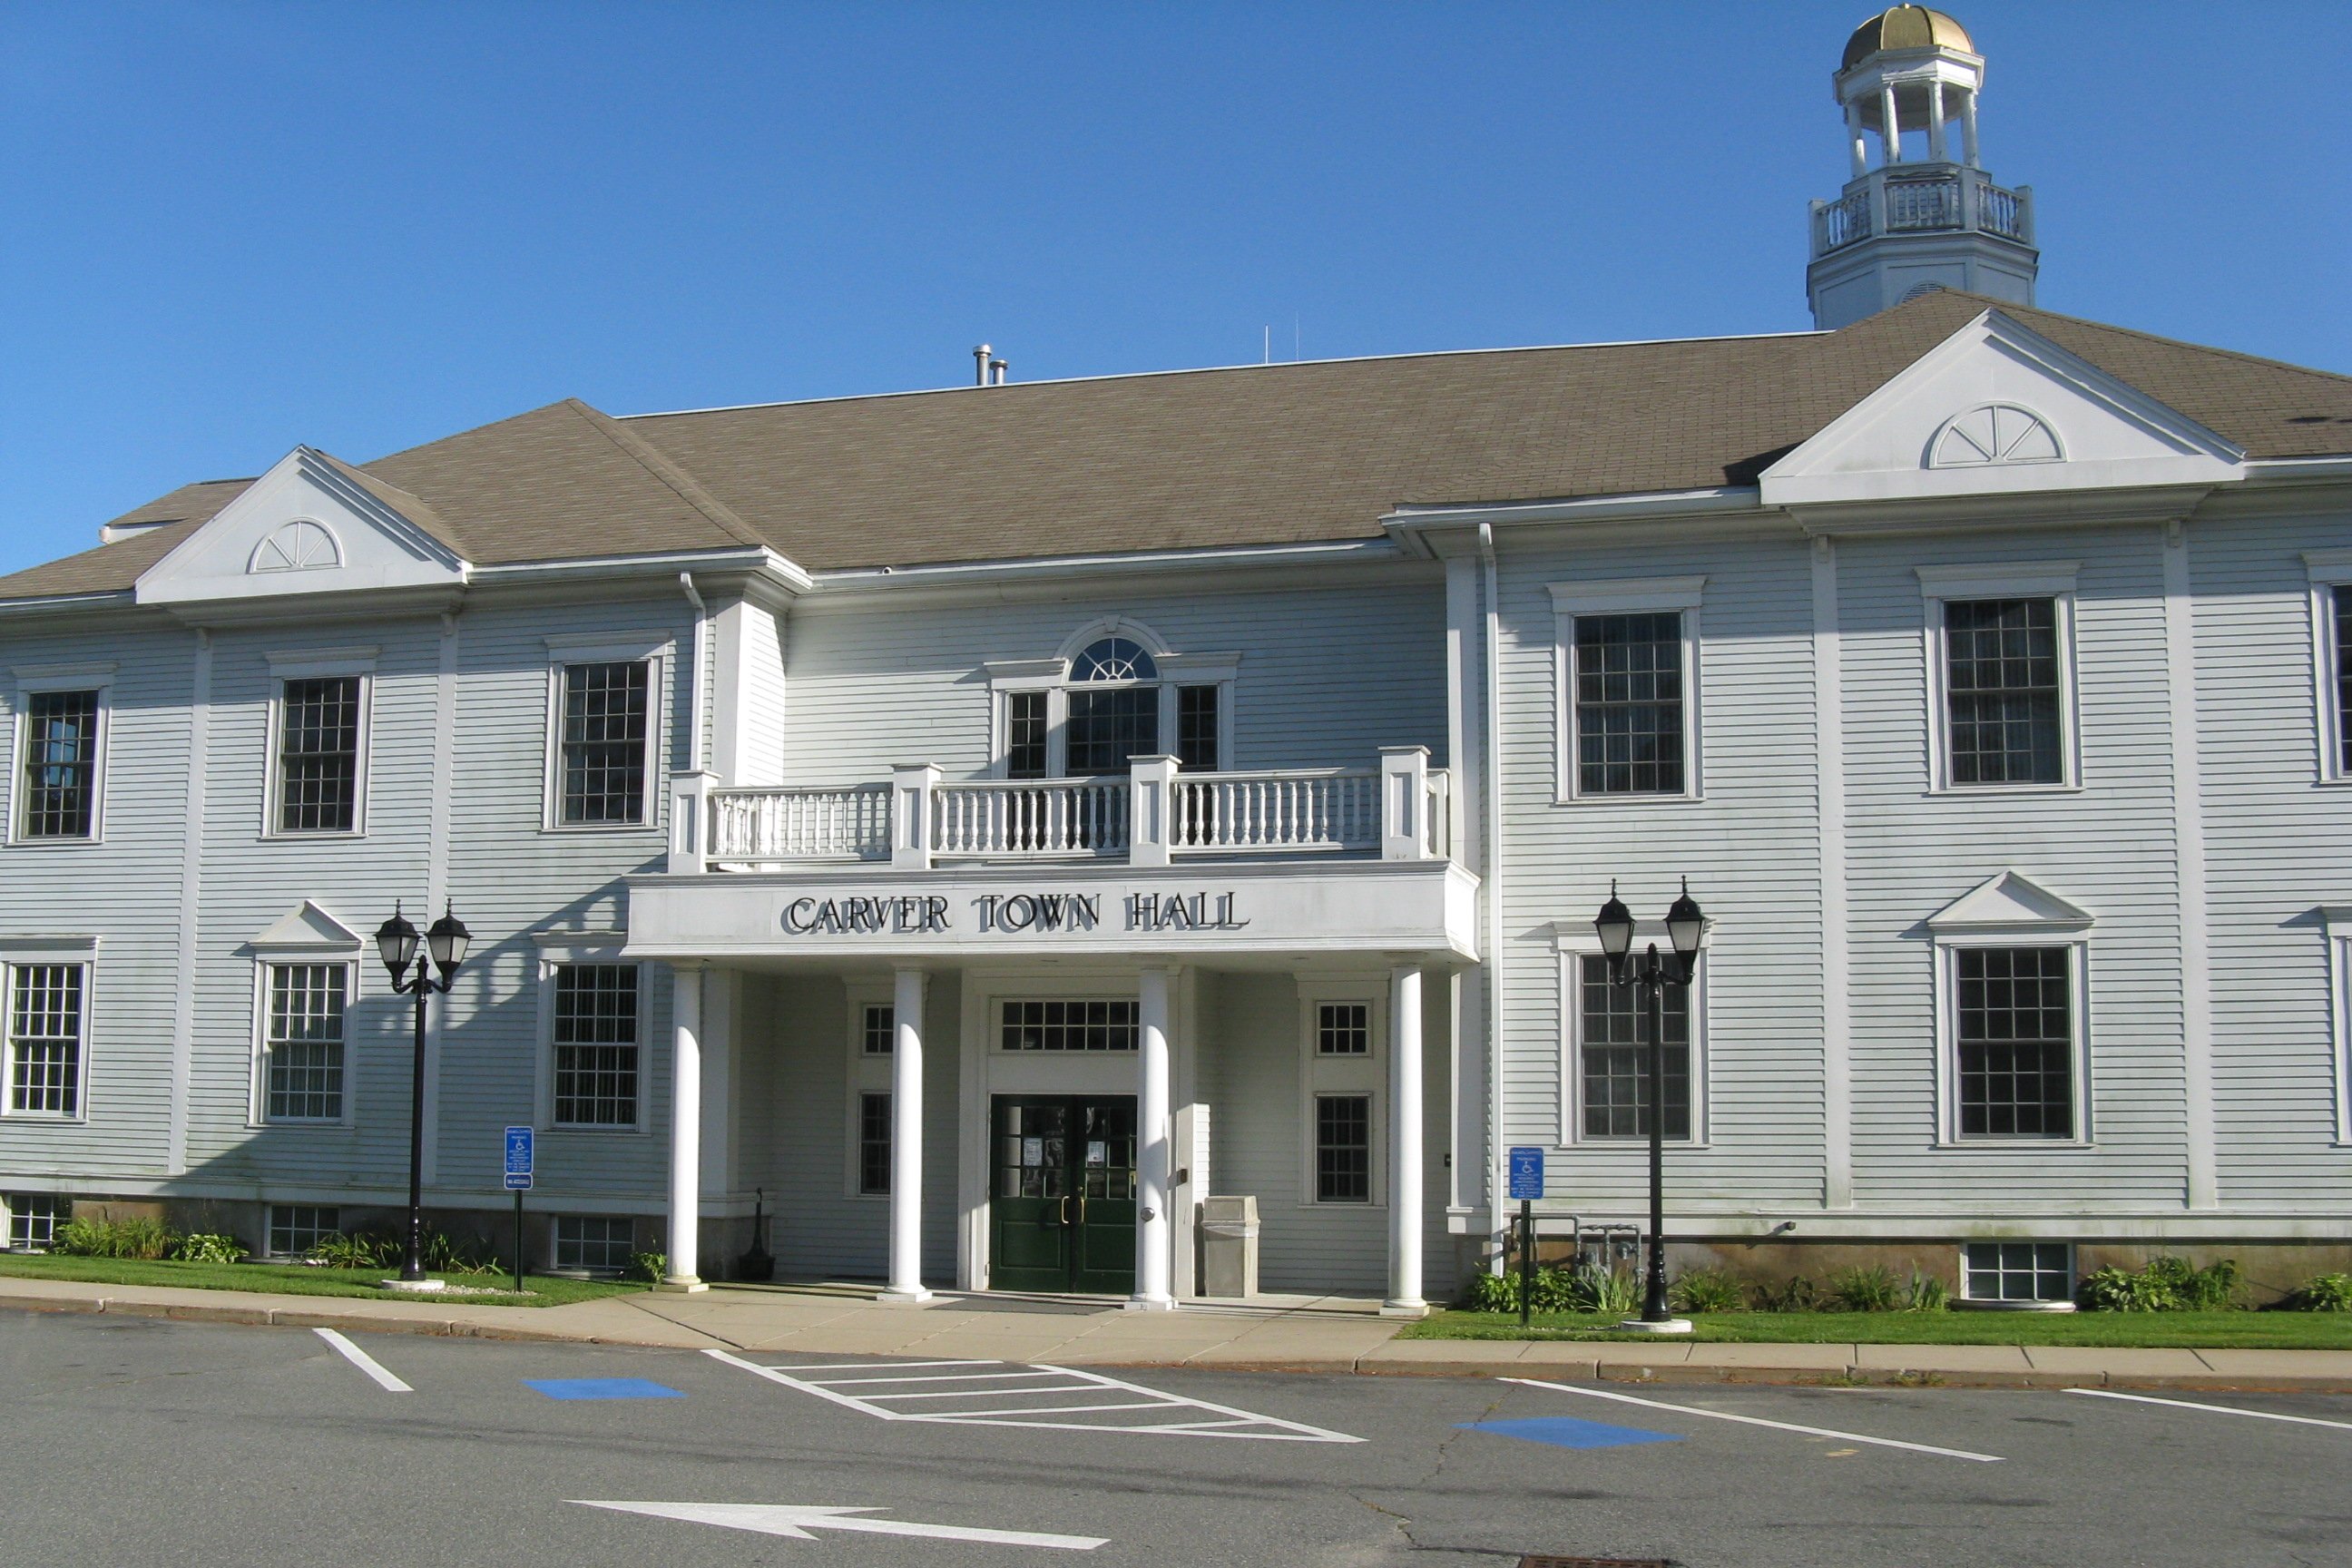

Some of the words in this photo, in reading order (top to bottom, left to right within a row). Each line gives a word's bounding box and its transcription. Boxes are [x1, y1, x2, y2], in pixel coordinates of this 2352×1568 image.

[789, 896, 952, 930] CARVER
[980, 893, 1102, 929] TOWN
[1132, 891, 1251, 926] HALL
